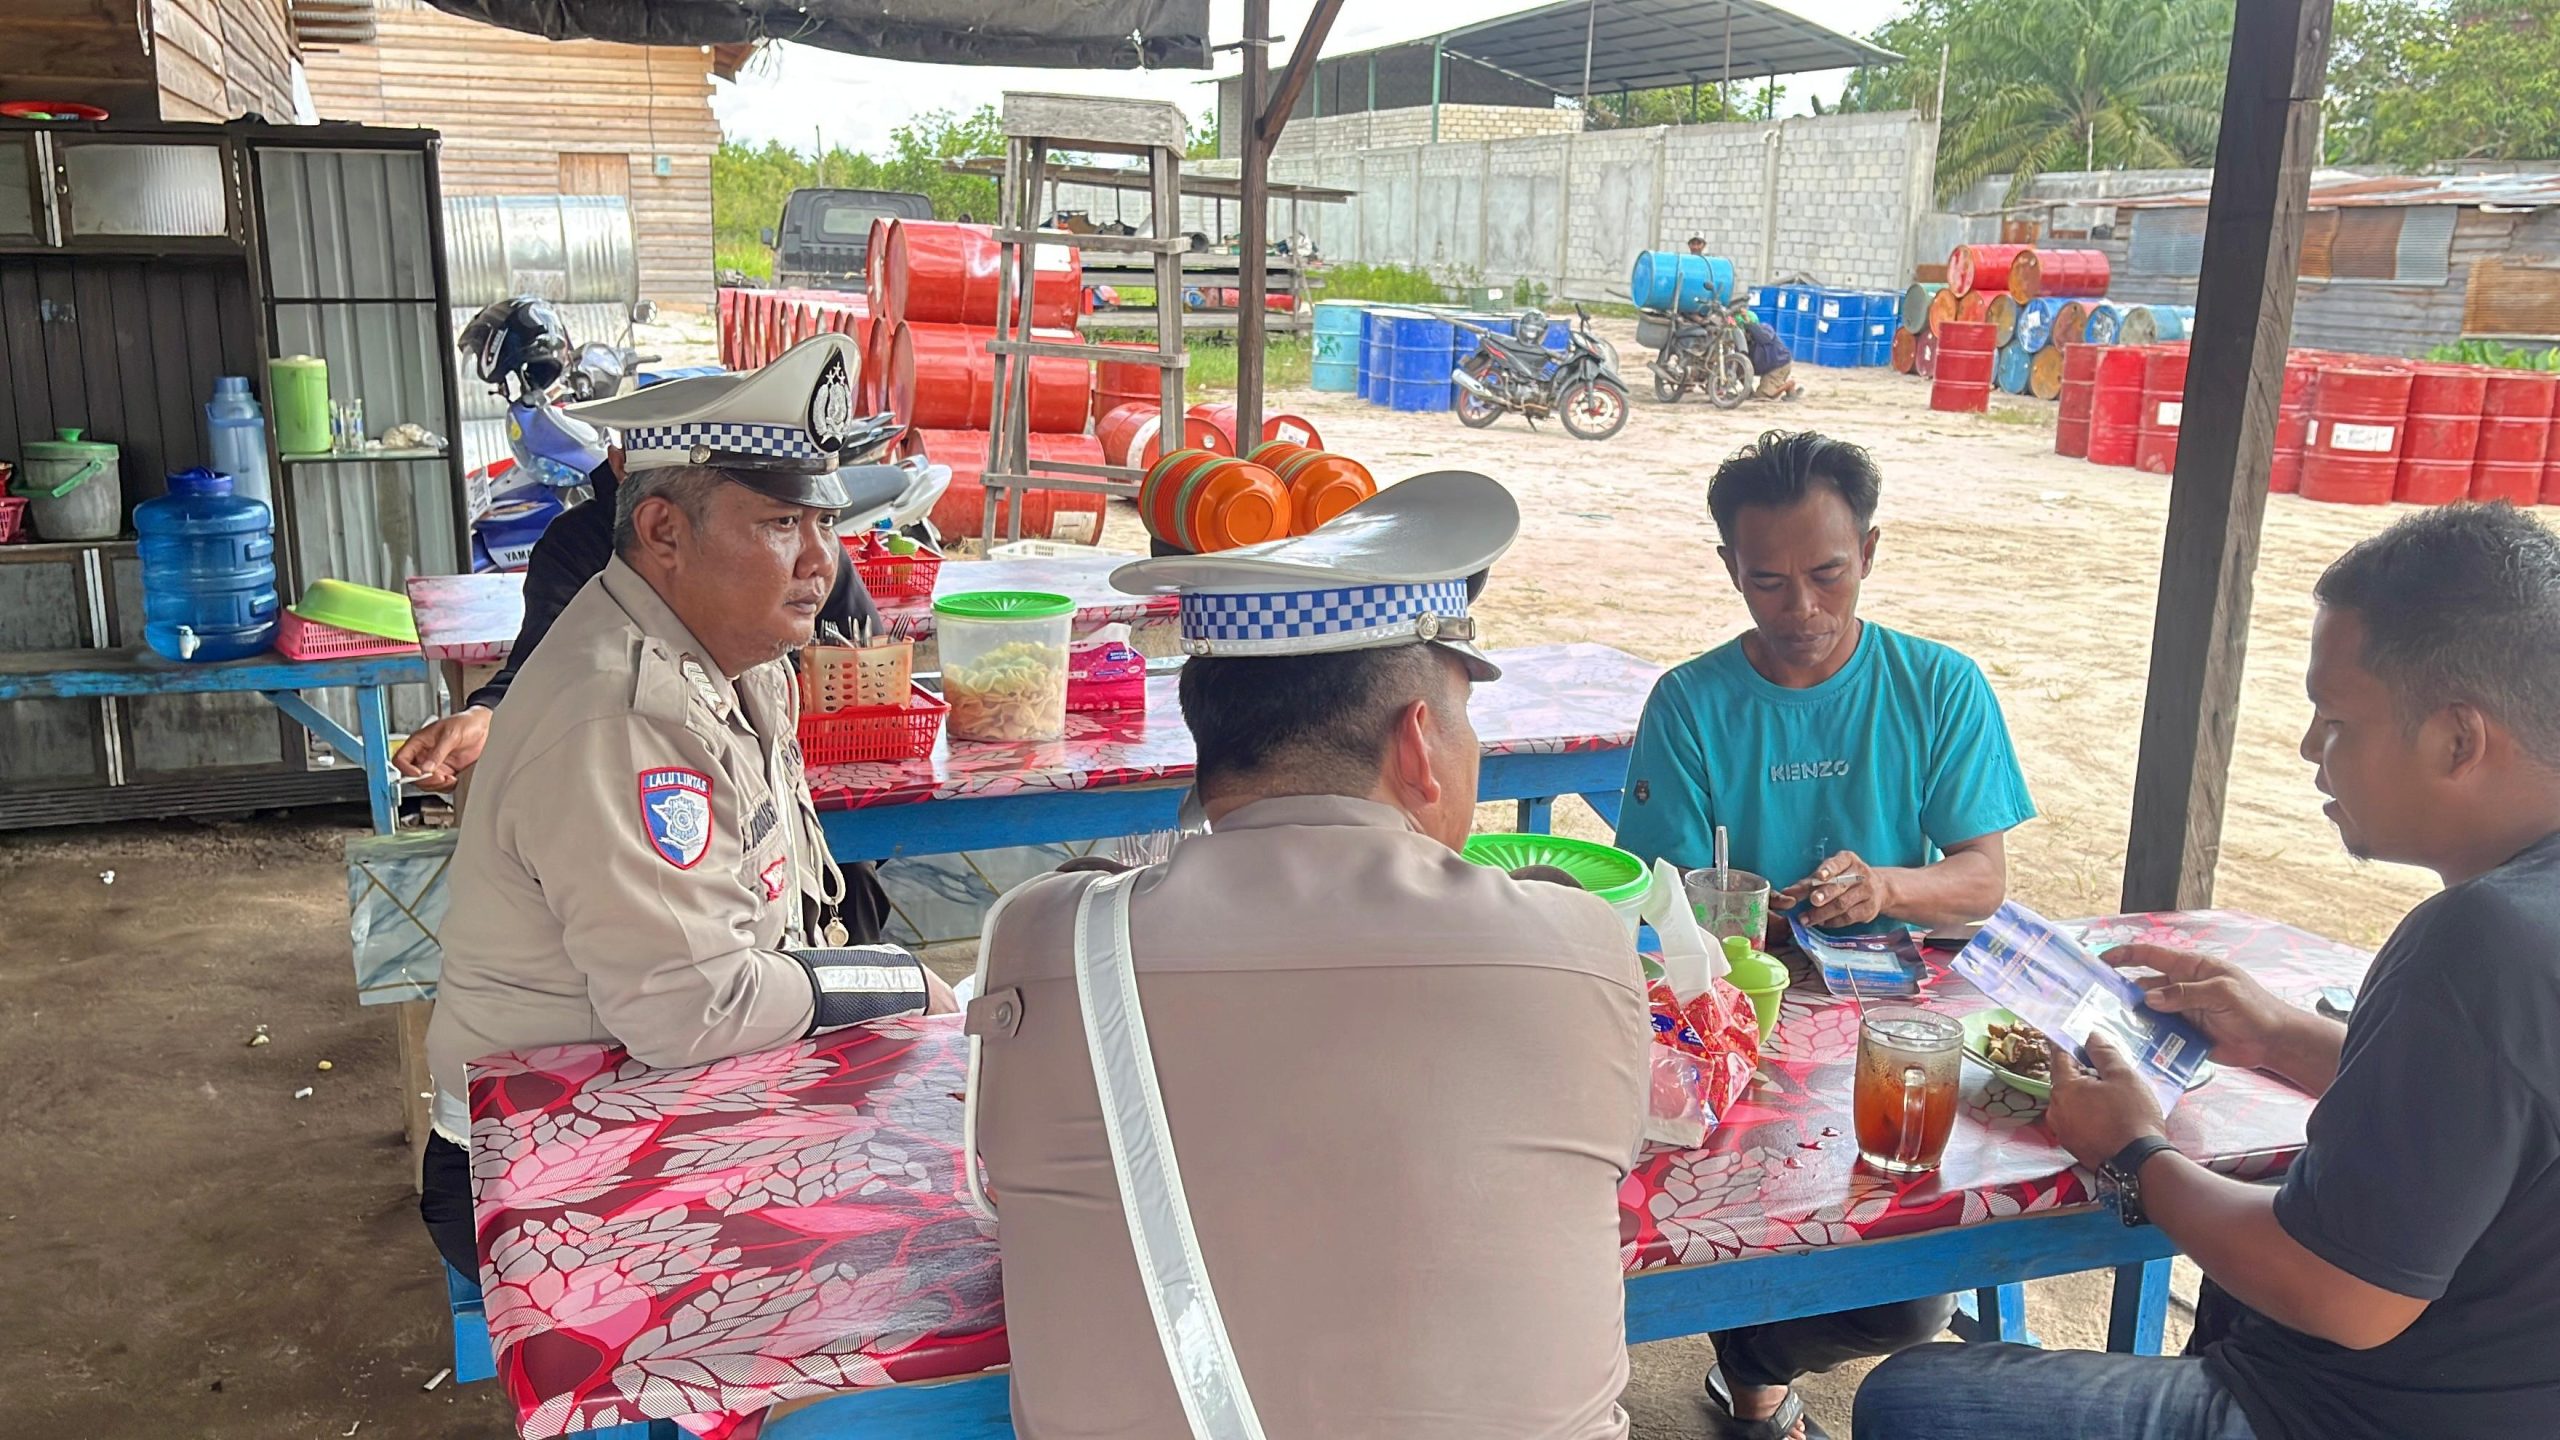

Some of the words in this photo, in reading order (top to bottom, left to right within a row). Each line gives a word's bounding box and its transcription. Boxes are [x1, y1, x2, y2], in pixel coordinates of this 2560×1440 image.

[1770, 760, 1849, 781] KENZO
[649, 772, 675, 788] LALU
[677, 772, 707, 792] LINTAS
